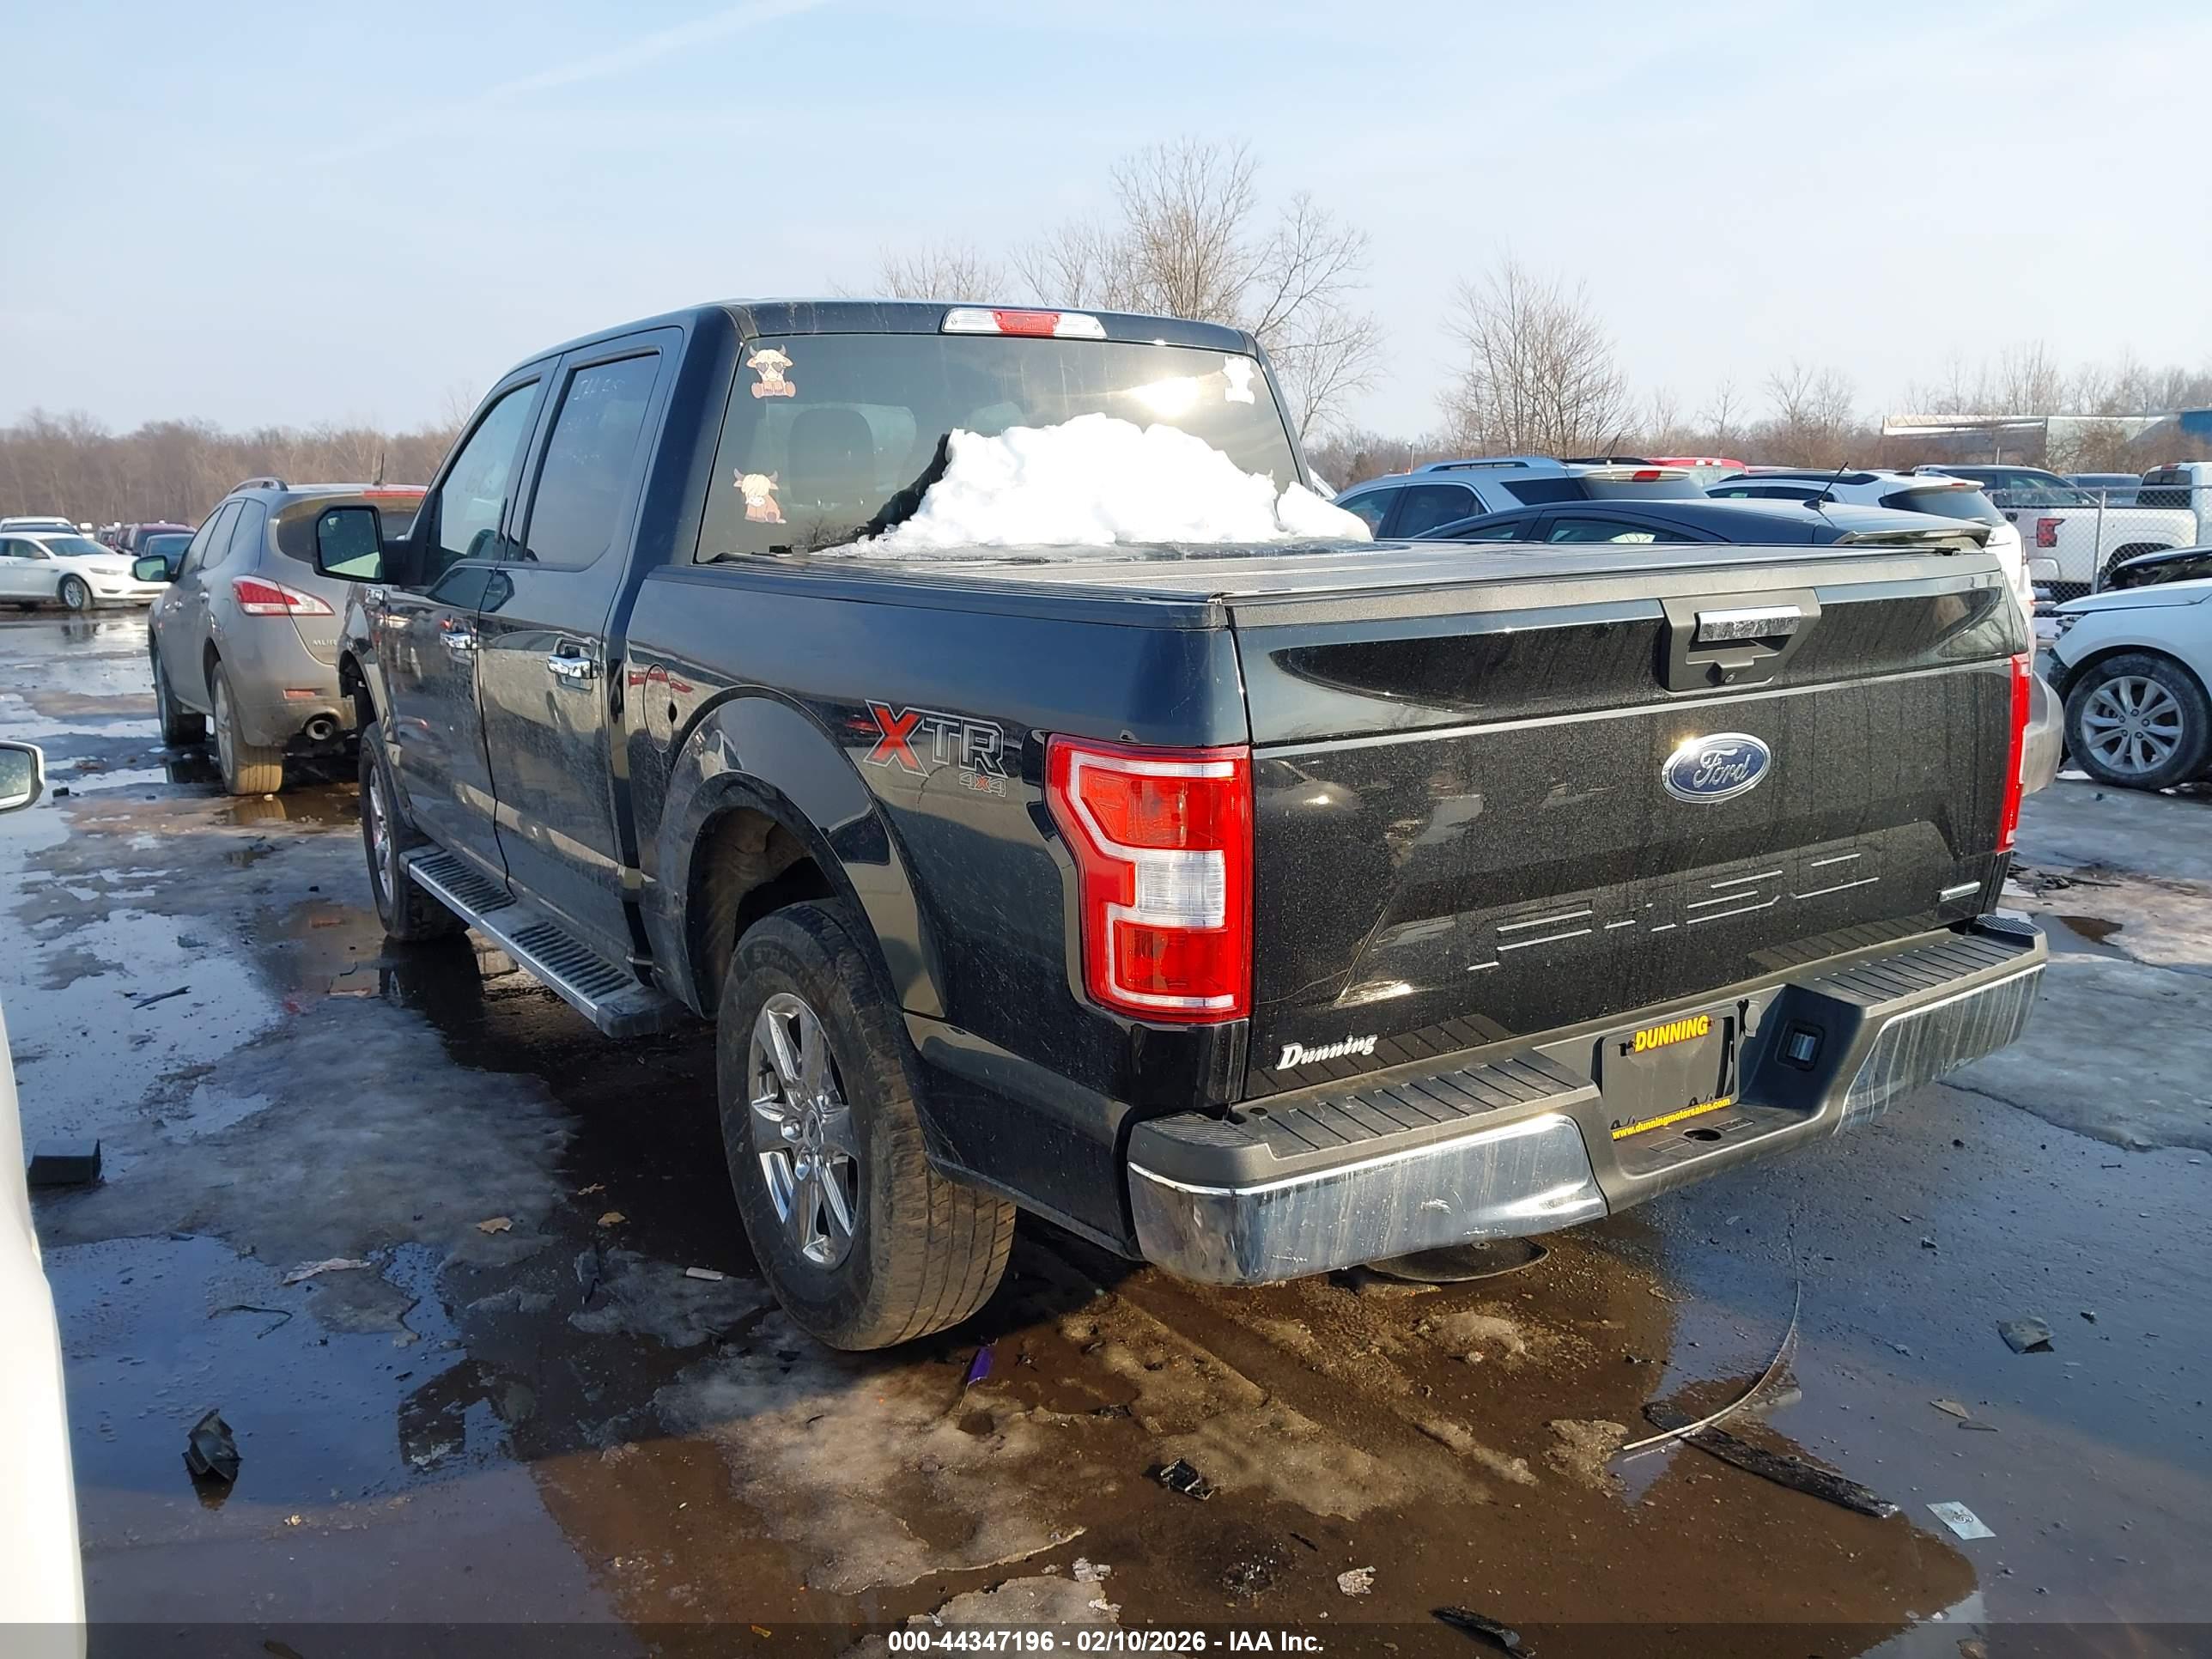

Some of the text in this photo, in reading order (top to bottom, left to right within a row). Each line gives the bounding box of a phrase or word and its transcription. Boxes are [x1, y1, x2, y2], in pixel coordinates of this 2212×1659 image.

[864, 699, 1008, 779] XTR
[1692, 748, 1752, 788] Ford
[1274, 1033, 1378, 1071] Dunning
[1634, 1014, 1710, 1053] DUNNING
[1611, 1097, 1731, 1139] www.dunningmotorsales.com
